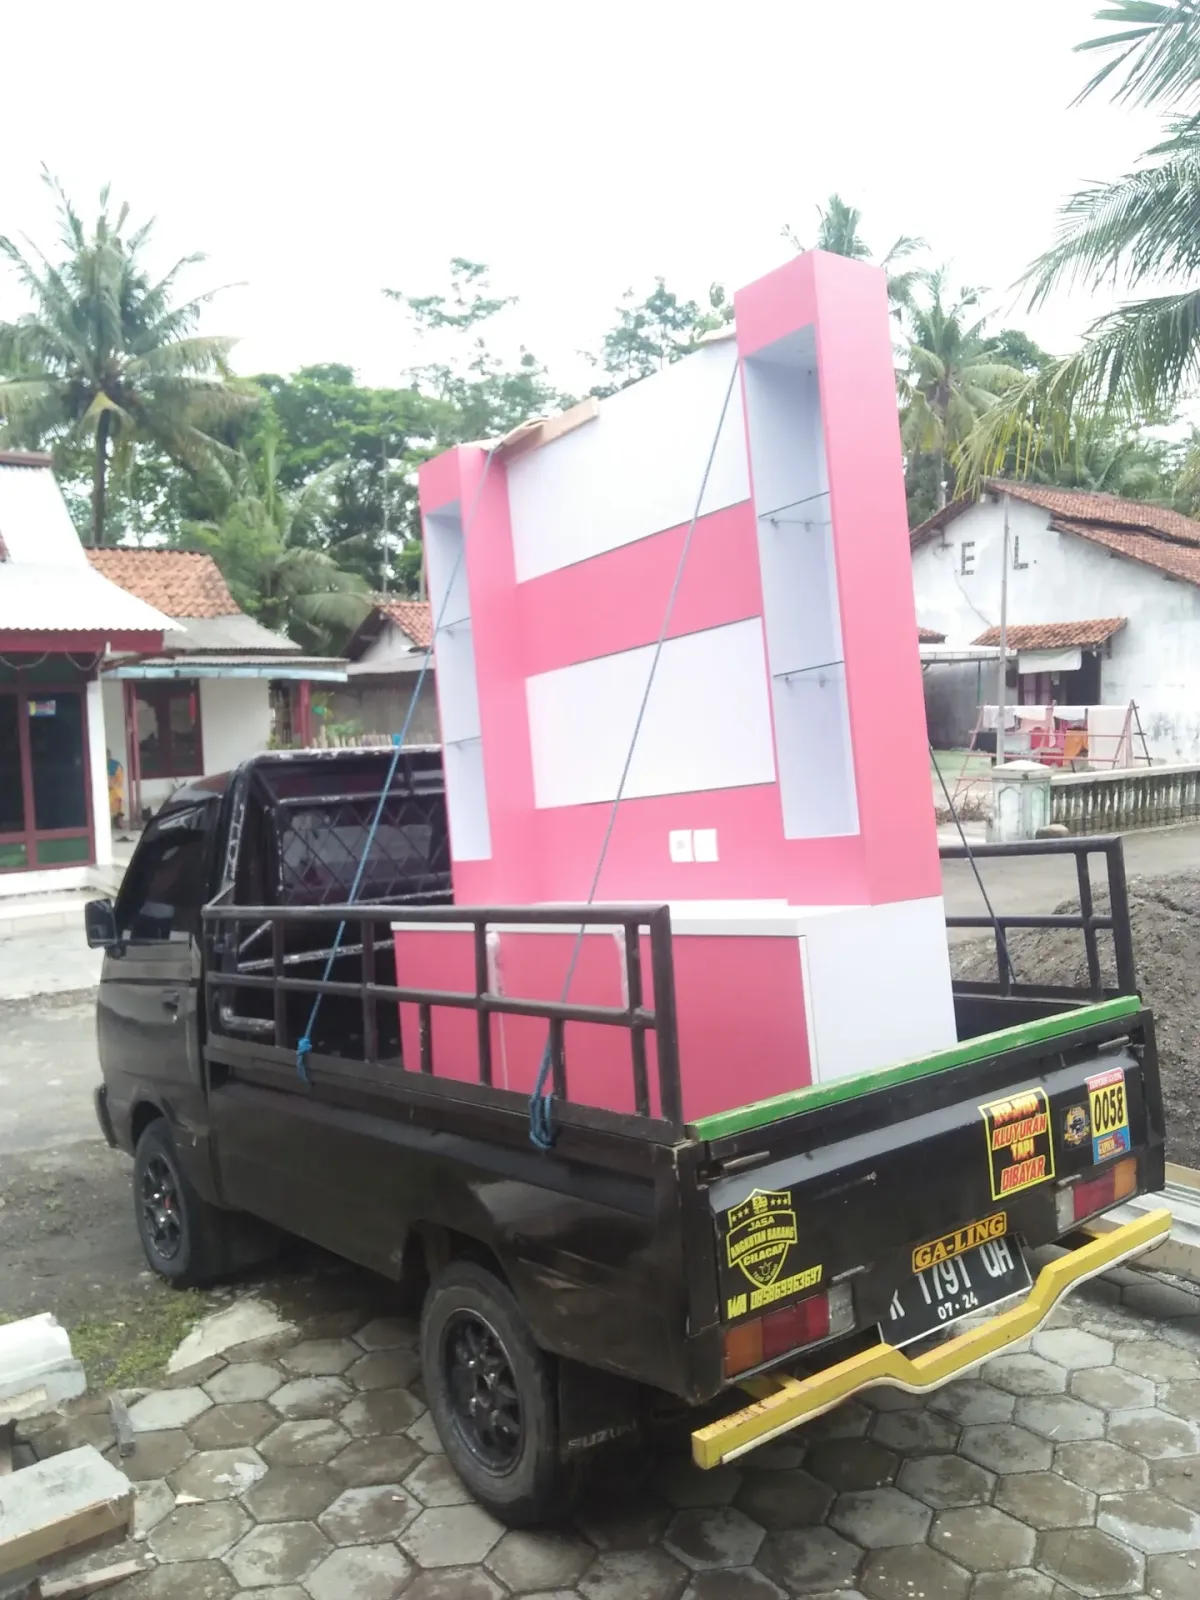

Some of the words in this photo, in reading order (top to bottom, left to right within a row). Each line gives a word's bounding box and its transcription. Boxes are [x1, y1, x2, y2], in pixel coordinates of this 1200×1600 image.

[1094, 1086, 1124, 1132] 0058
[992, 1112, 1047, 1150] KLUYURAN
[1001, 1155, 1045, 1192] DIBAYAR
[748, 1216, 775, 1231] JASA
[730, 1230, 766, 1259] ANGKUTAN
[743, 1243, 785, 1266] CILACAP
[915, 1216, 1004, 1268] GA-LING
[727, 1293, 747, 1320] WA
